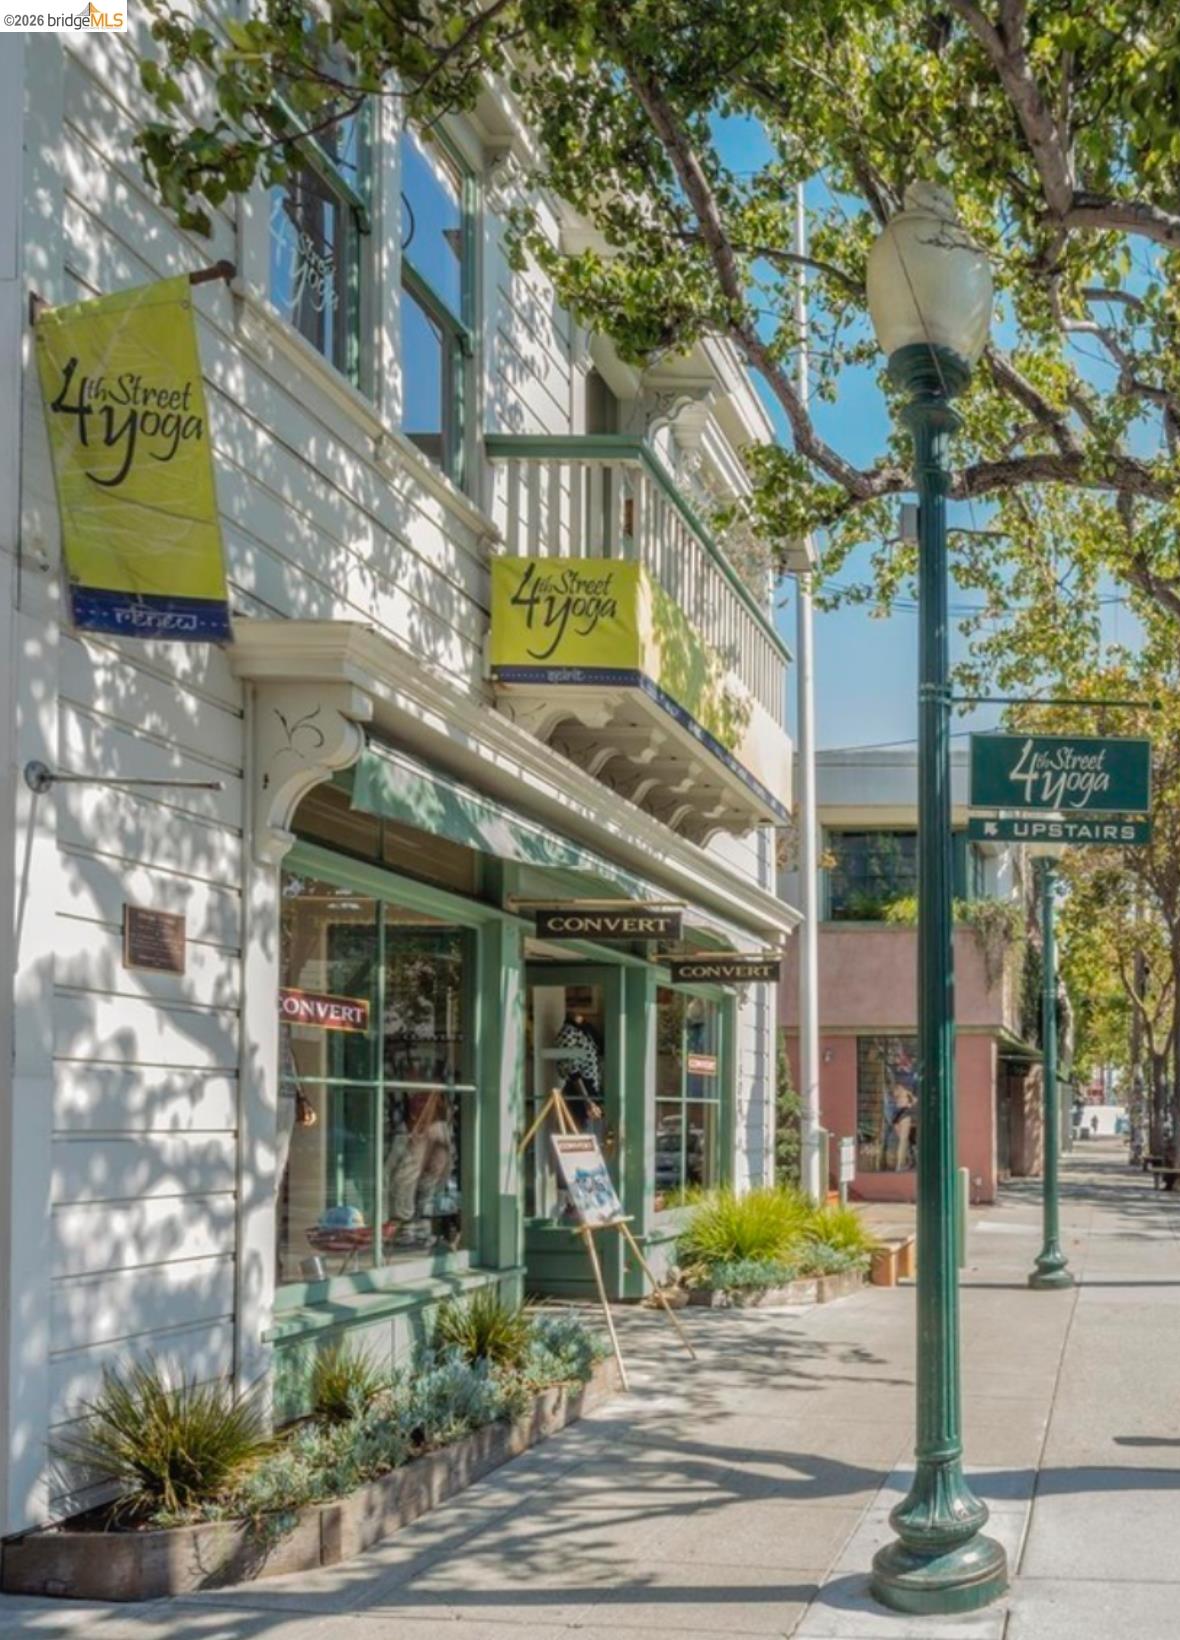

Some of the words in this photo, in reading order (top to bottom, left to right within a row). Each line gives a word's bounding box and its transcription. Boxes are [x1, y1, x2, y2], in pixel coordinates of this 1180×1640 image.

[108, 372, 192, 411] Street
[553, 568, 614, 596] Street
[1050, 746, 1107, 770] Street
[1013, 822, 1136, 840] UPSTAIRS
[547, 917, 672, 933] CONVERT
[679, 965, 773, 978] CONVERT
